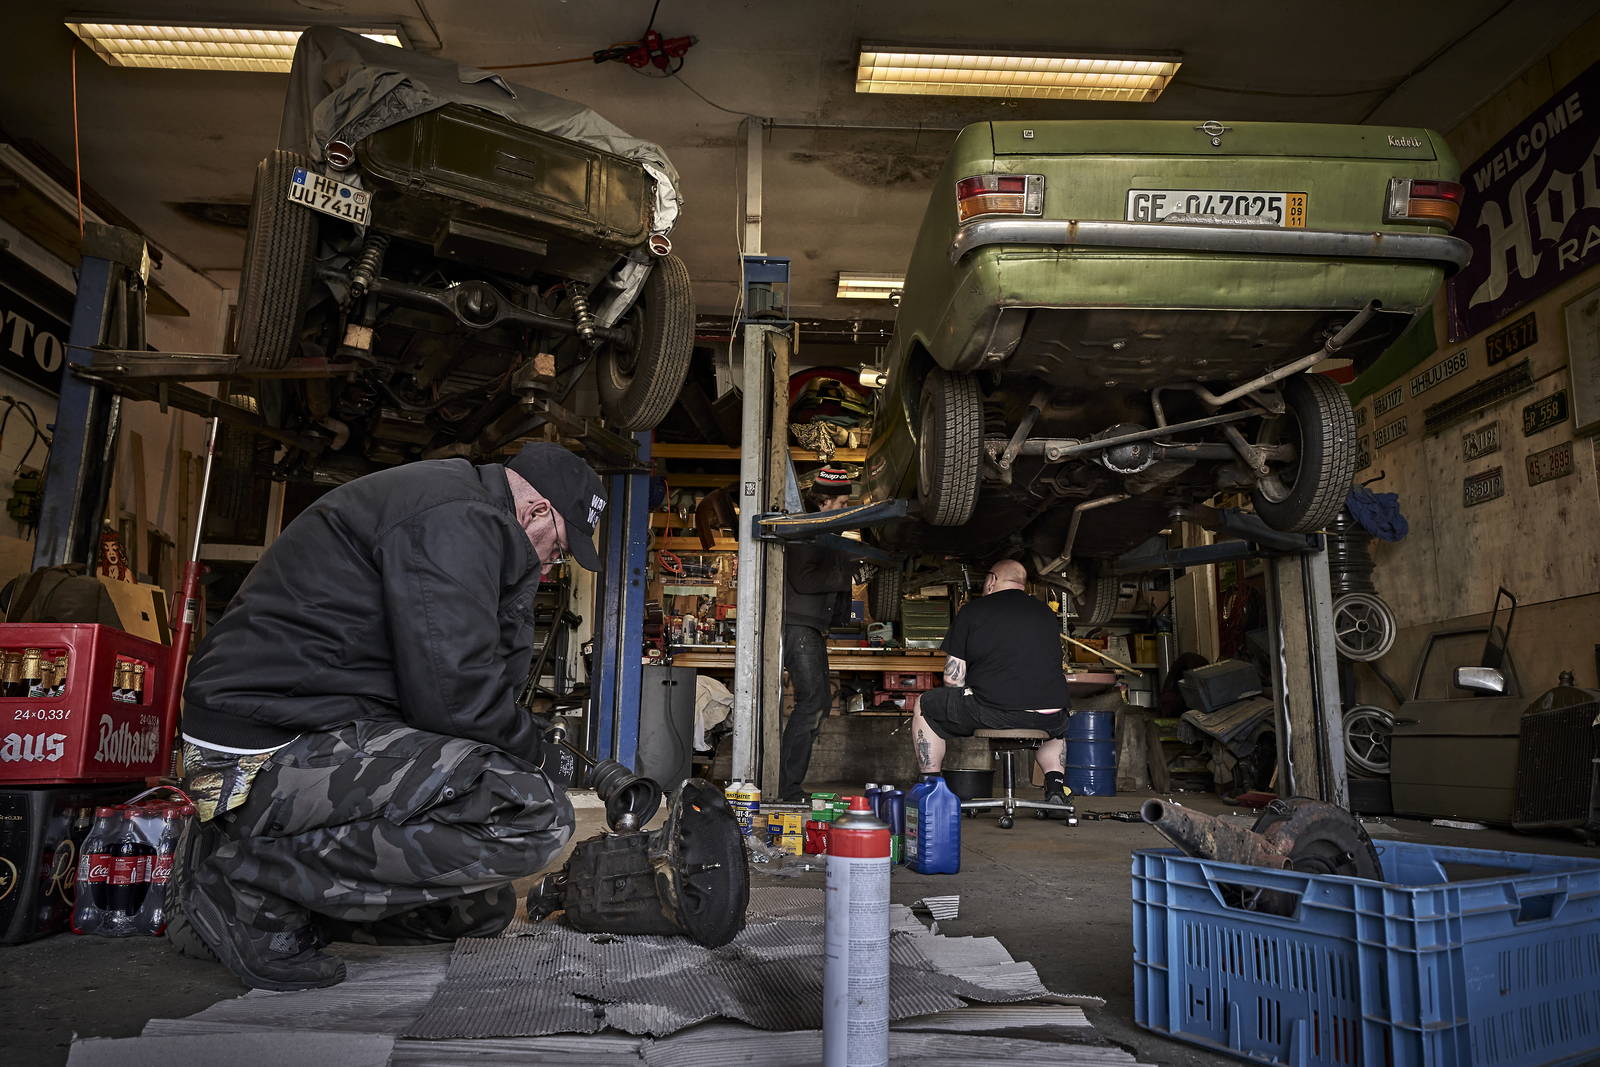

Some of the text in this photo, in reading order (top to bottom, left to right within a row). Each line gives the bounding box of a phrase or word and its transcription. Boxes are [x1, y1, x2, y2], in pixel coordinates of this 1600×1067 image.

[1474, 91, 1585, 193] WELCOME
[314, 175, 339, 197] HH
[292, 185, 367, 223] UU 741H
[1134, 193, 1167, 223] GE
[1291, 197, 1303, 208] 12
[1291, 208, 1303, 217] 09
[1291, 217, 1303, 226] 11
[0, 310, 67, 374] TO
[1444, 353, 1467, 377] 1968
[93, 713, 160, 768] Rothaus
